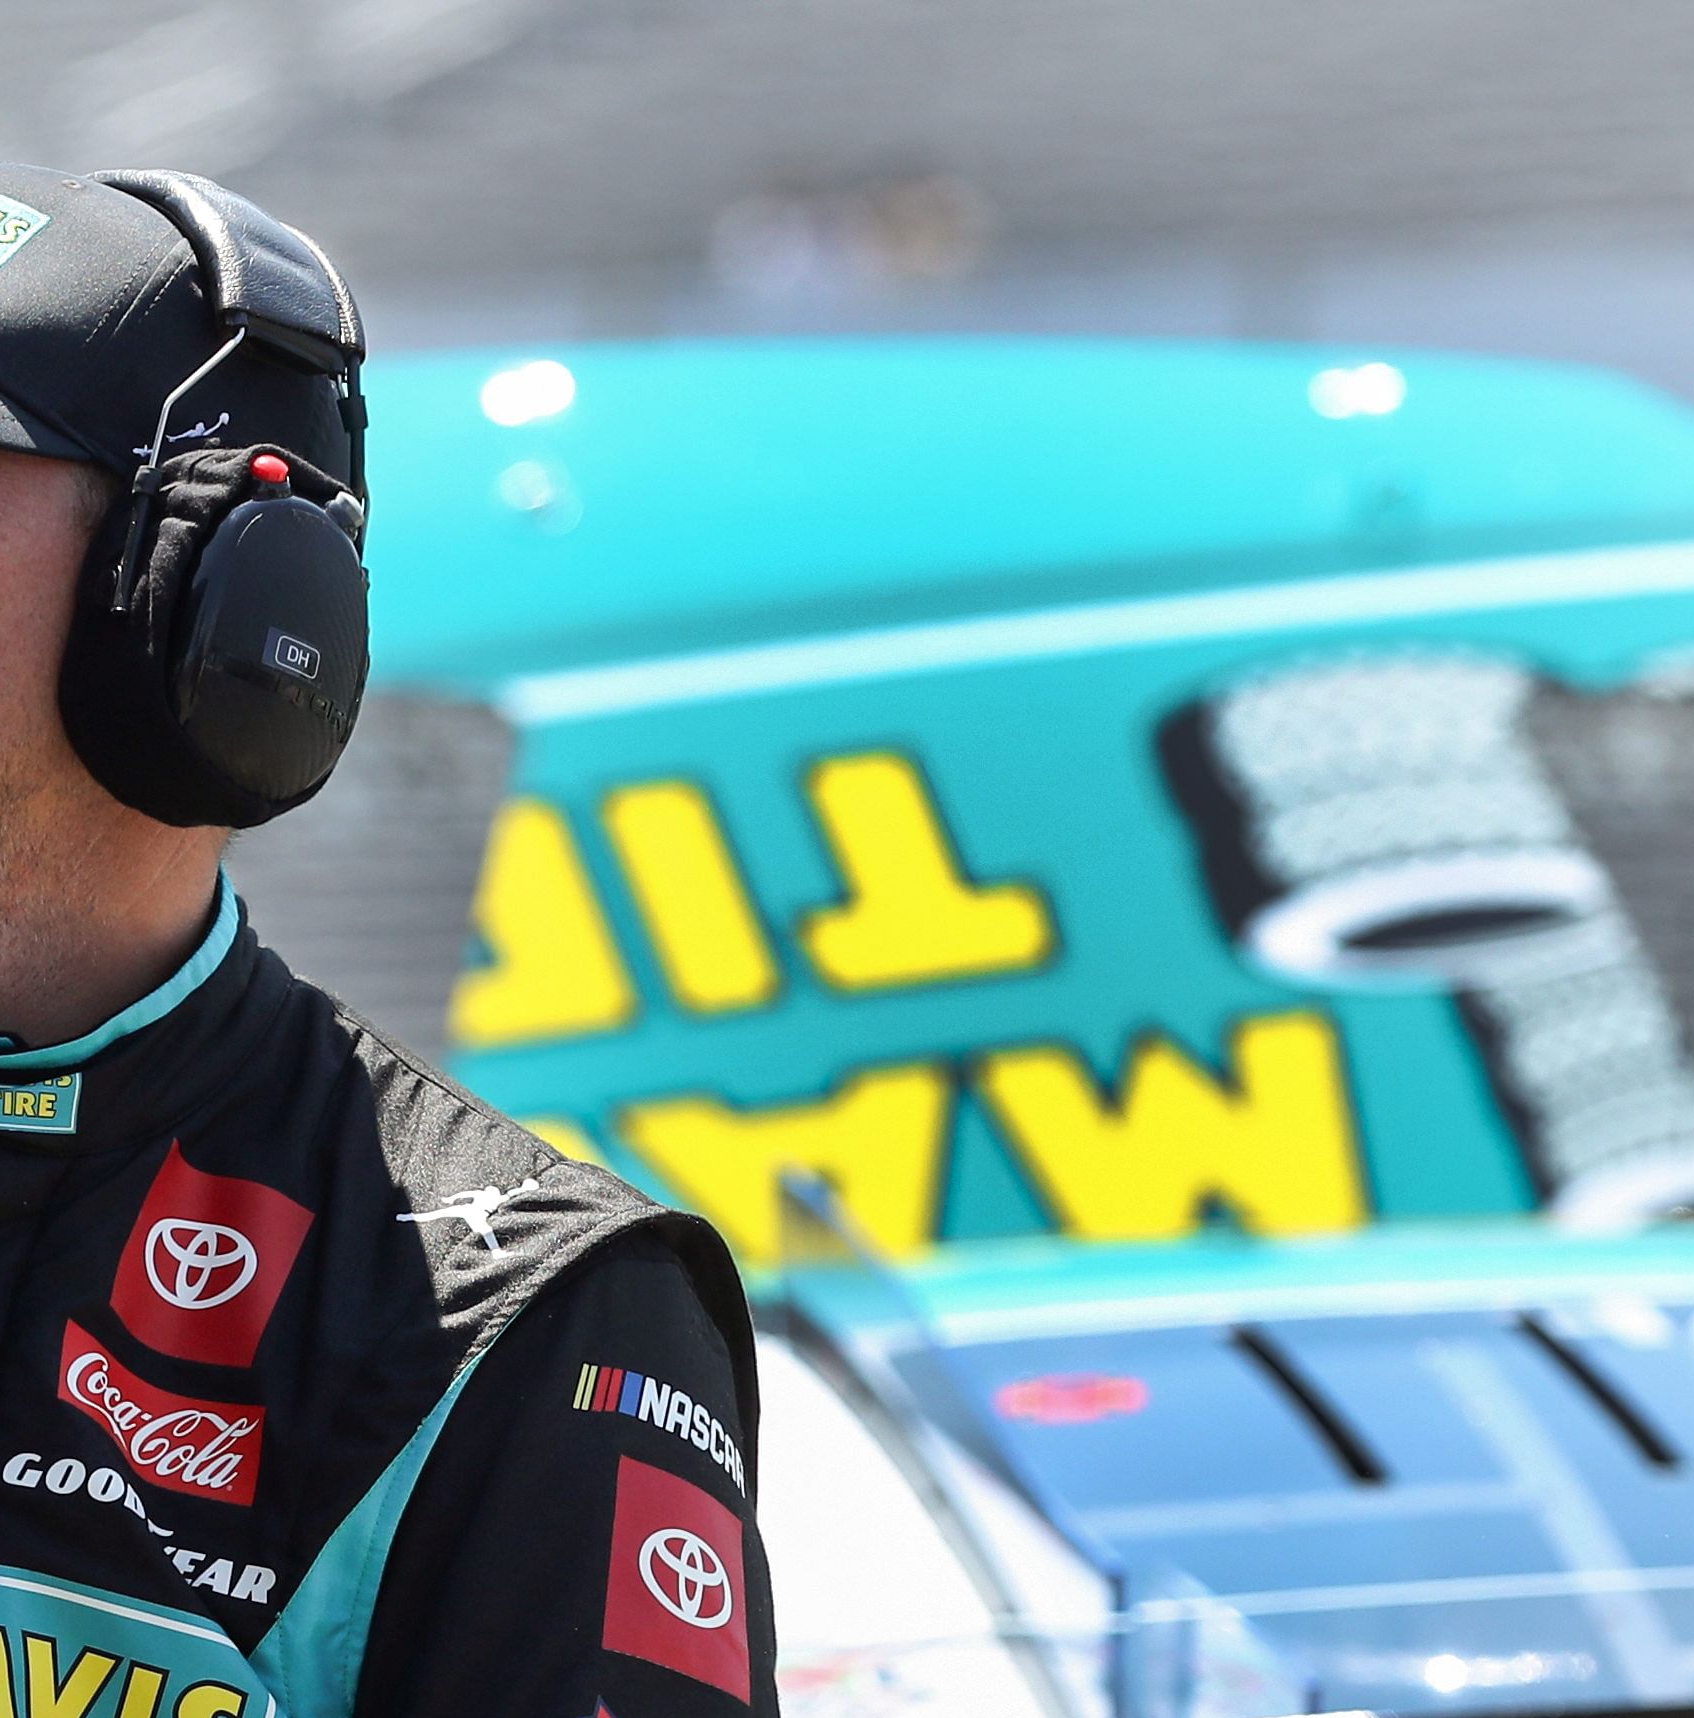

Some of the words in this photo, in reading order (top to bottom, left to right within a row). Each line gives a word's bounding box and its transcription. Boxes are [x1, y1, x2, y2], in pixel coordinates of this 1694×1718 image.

[286, 644, 311, 669] DH
[65, 1351, 260, 1491] Coca-Cola
[637, 1375, 748, 1500] NASCAR
